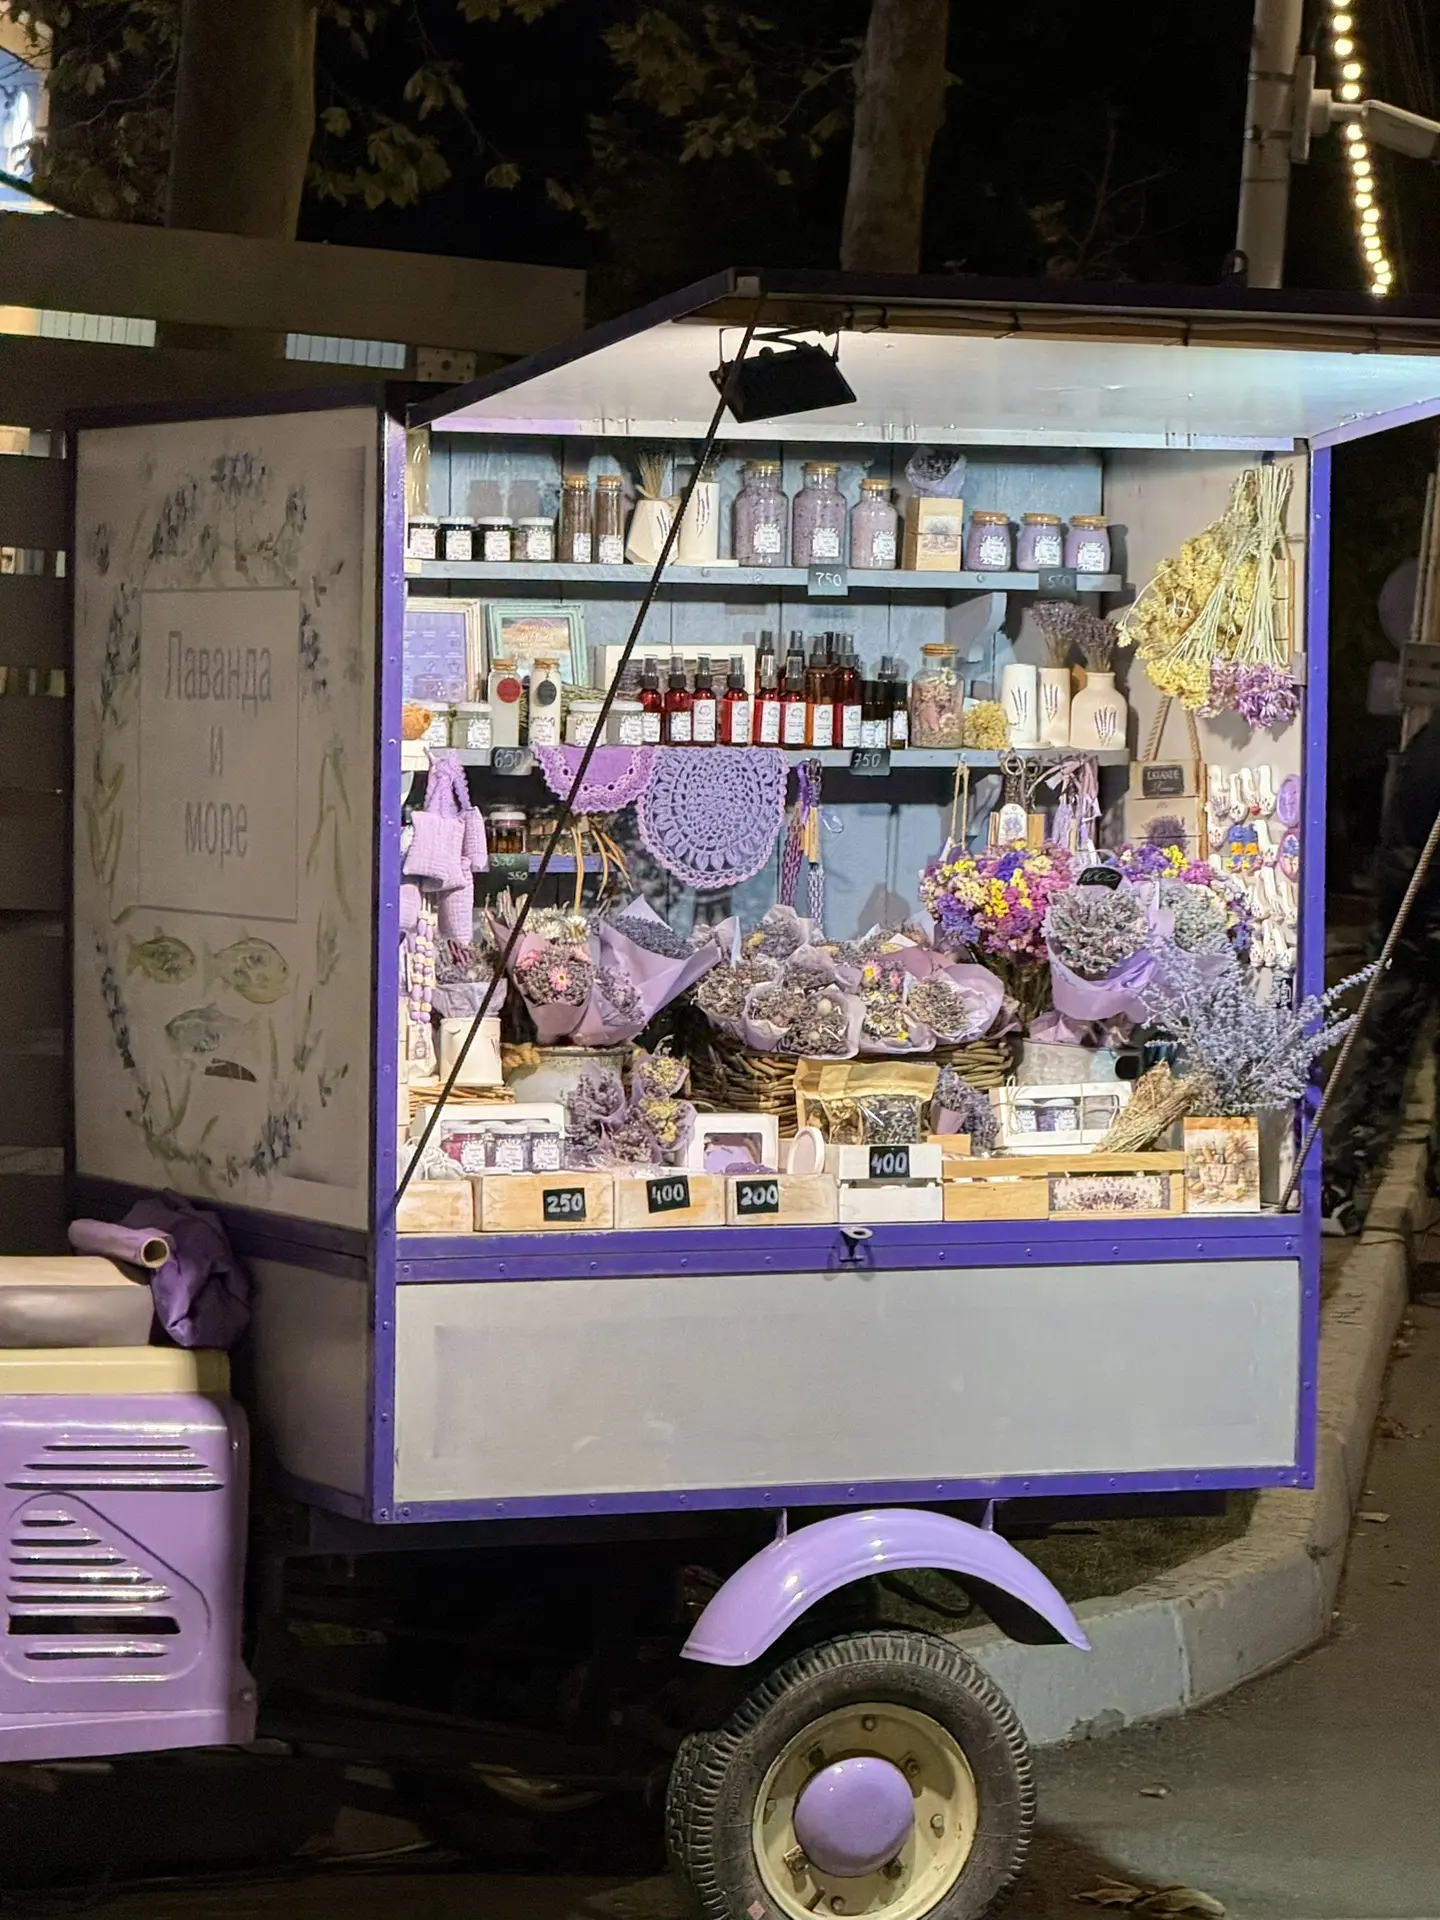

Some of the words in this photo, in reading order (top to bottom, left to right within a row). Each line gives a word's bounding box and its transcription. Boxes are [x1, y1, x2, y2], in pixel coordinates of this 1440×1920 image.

[815, 571, 842, 587] 750
[494, 748, 524, 769] 650
[854, 752, 882, 768] 750
[871, 1152, 908, 1175] 400
[546, 1192, 583, 1213] 250
[651, 1182, 685, 1205] 400
[740, 1184, 779, 1206] 200
